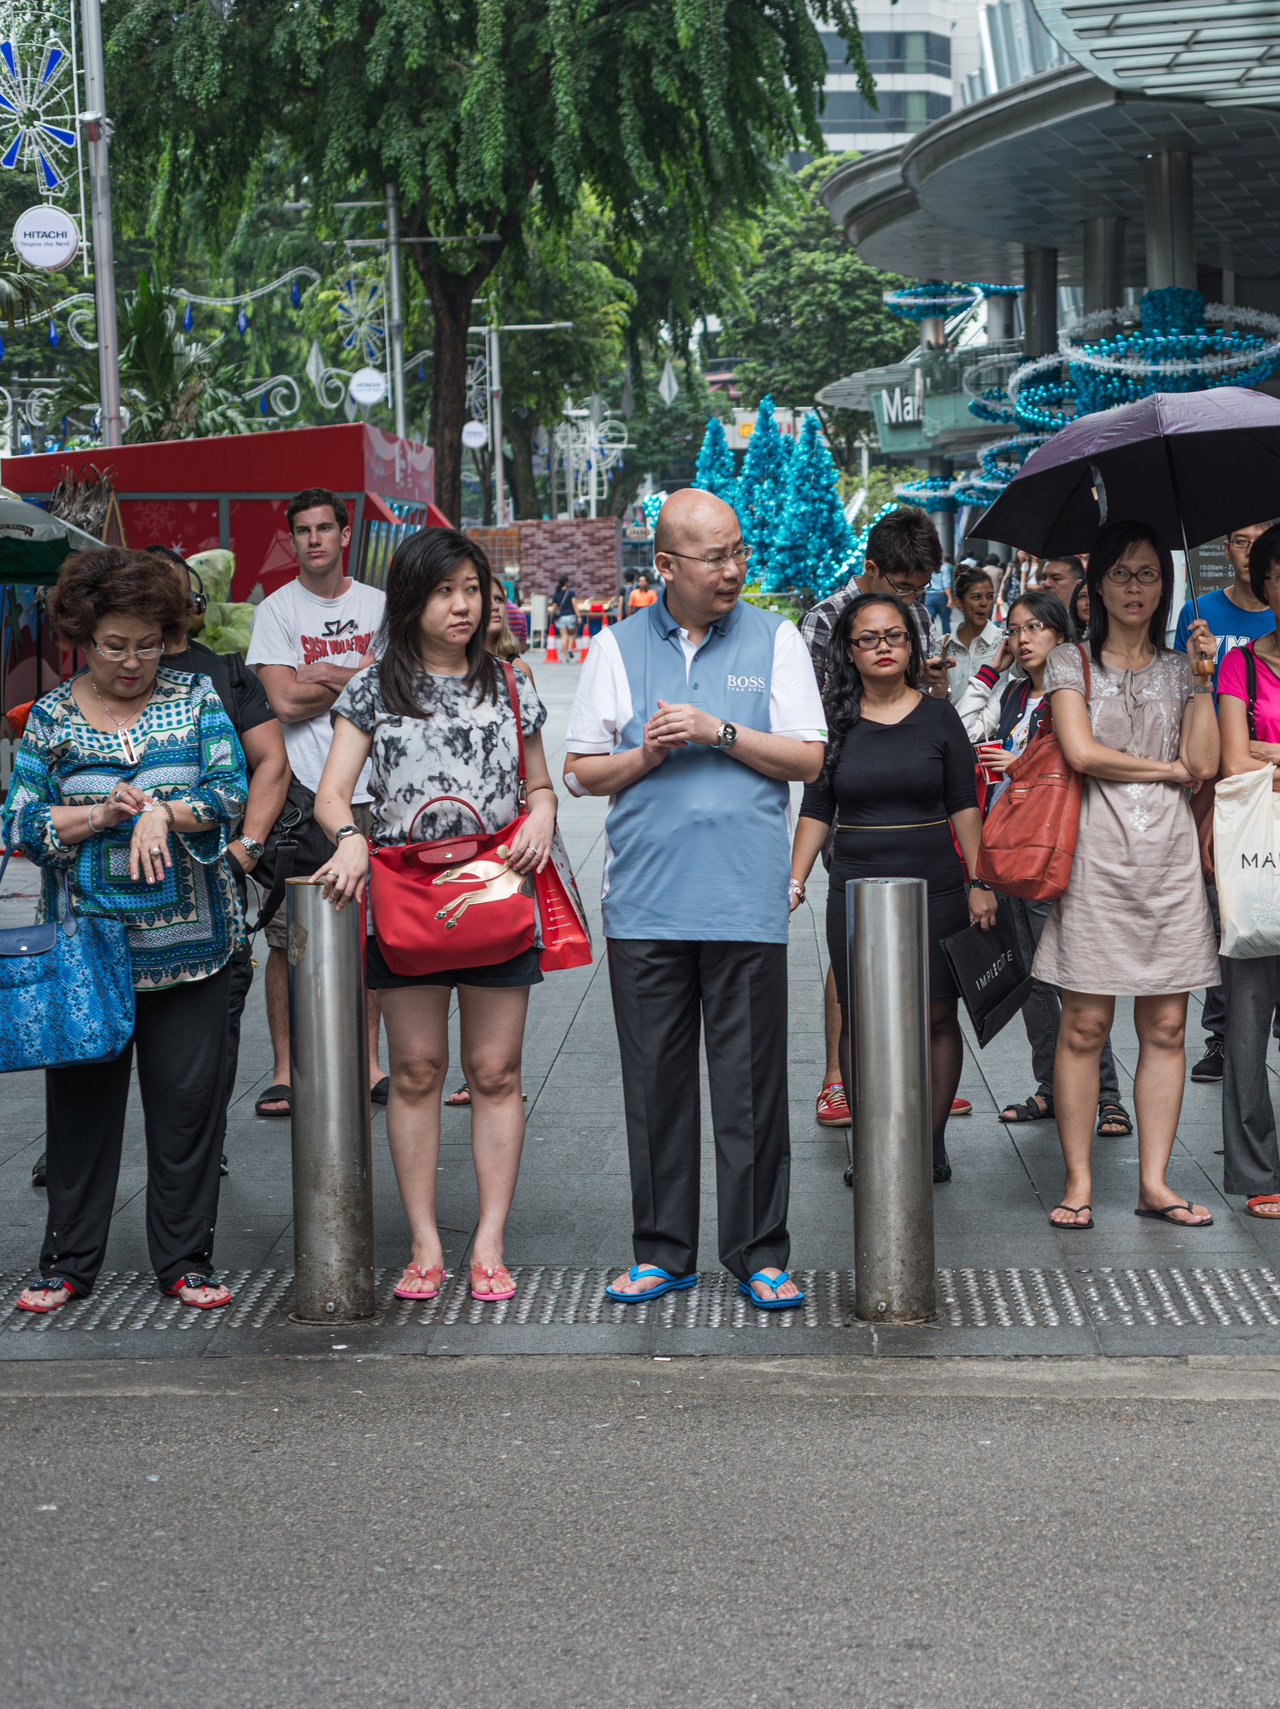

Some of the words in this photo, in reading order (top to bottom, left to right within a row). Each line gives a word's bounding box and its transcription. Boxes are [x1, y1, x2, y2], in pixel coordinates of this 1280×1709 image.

[23, 230, 68, 239] HITACHI
[301, 634, 329, 665] SASK
[727, 674, 766, 689] BOSS
